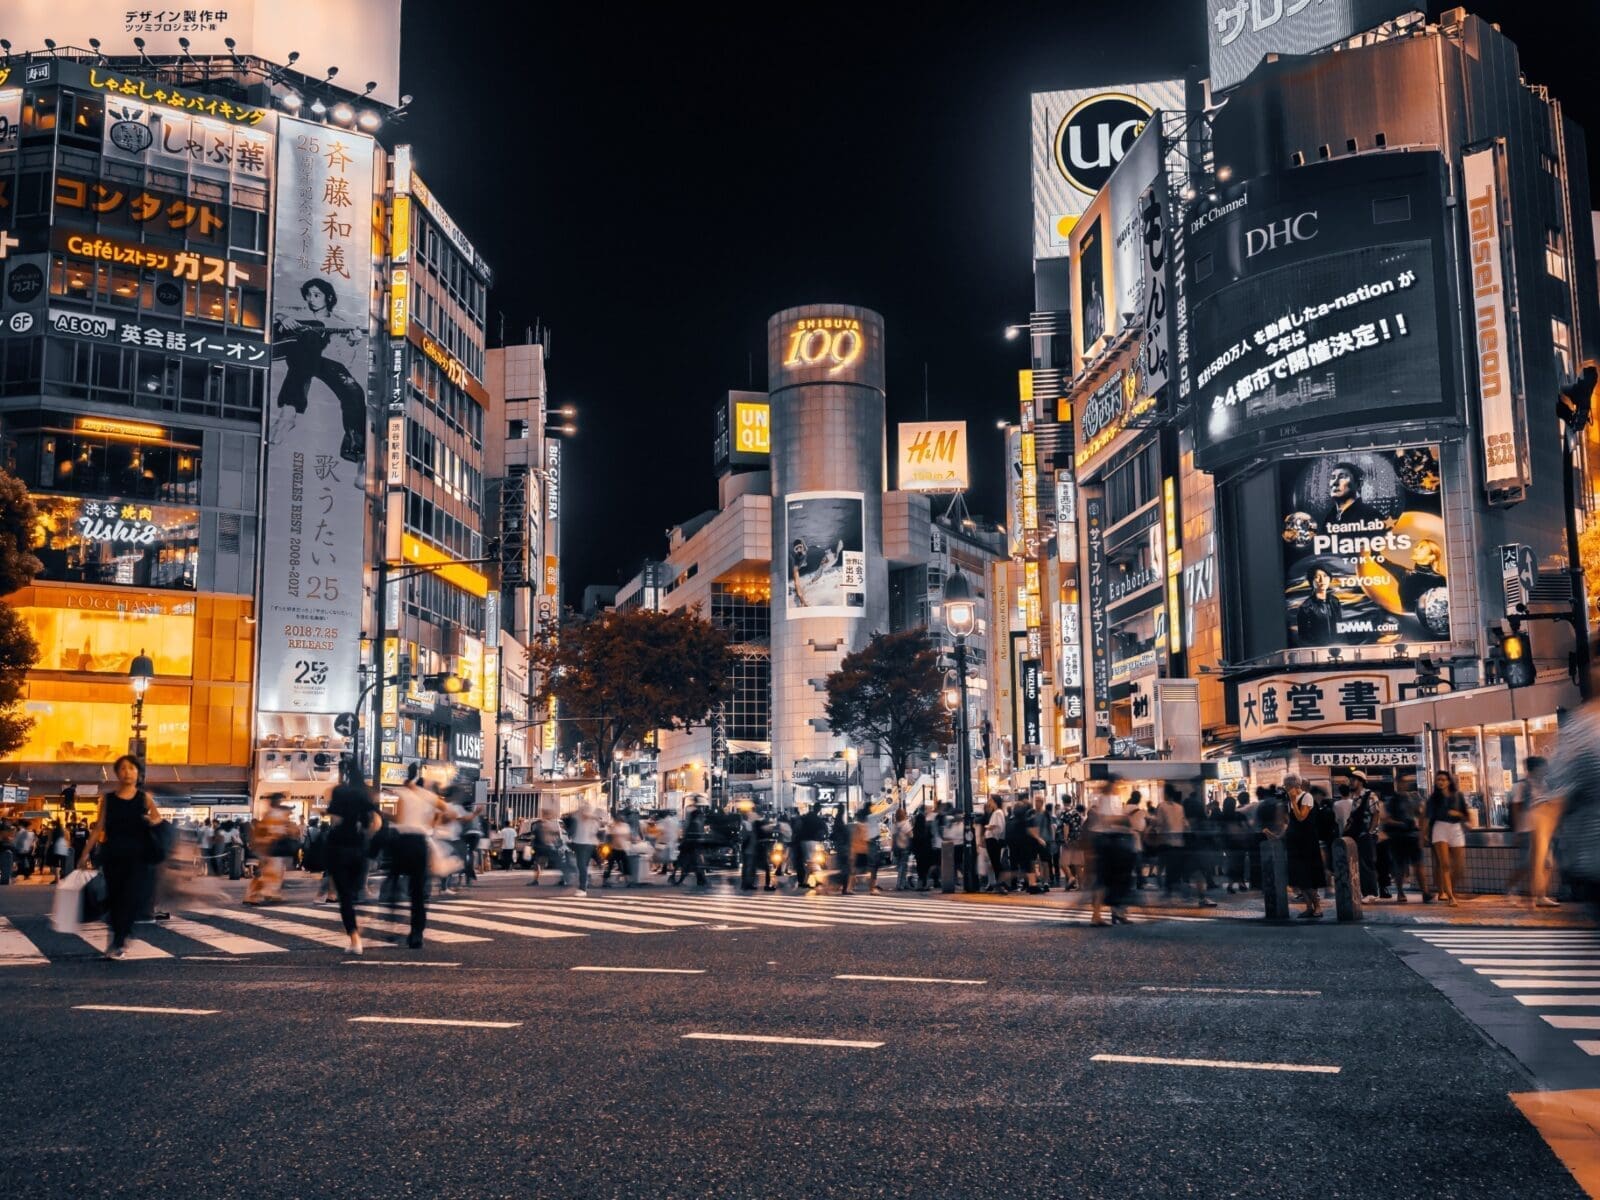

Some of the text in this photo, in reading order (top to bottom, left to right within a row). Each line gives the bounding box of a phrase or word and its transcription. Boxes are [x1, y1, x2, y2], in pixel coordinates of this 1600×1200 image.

[125, 10, 228, 23] デザイン製作中
[28, 65, 48, 80] 寿司
[88, 67, 266, 126] しゃぶしゃぶバイキング
[163, 124, 265, 172] しゃぶ葉
[55, 177, 224, 235] コンタクト
[320, 140, 355, 280] 斉藤和義
[1190, 193, 1249, 235] DHC Channel
[1245, 210, 1319, 258] DHC
[68, 236, 250, 288] Caféレストラン ガスト
[1469, 184, 1502, 399] Taisei neon
[13, 315, 31, 330] 6F
[55, 314, 265, 361] AEON 英会話イーオン
[797, 318, 860, 331] SHIBUYA
[782, 327, 864, 375] 109
[1265, 329, 1307, 358] 今年は
[391, 423, 401, 479] 渋谷駅前ビル
[741, 429, 769, 448] QL
[907, 429, 959, 465] H&M
[548, 445, 558, 520] BIC CAMERA
[78, 516, 158, 546] Ushi8
[288, 452, 304, 598] SINGLES BEST 2008-2017
[1326, 518, 1385, 534] teamLab
[1313, 532, 1412, 556] Planets
[1342, 555, 1385, 565] TOKYO
[1089, 527, 1104, 647] サマーフルーツギフト
[1109, 568, 1150, 601] Euphoria
[1340, 575, 1391, 588] TOYOSU
[284, 624, 339, 639] 2018.7.25
[288, 639, 335, 651] RELEASE
[295, 660, 329, 685] 25
[455, 732, 481, 758] LUSH
